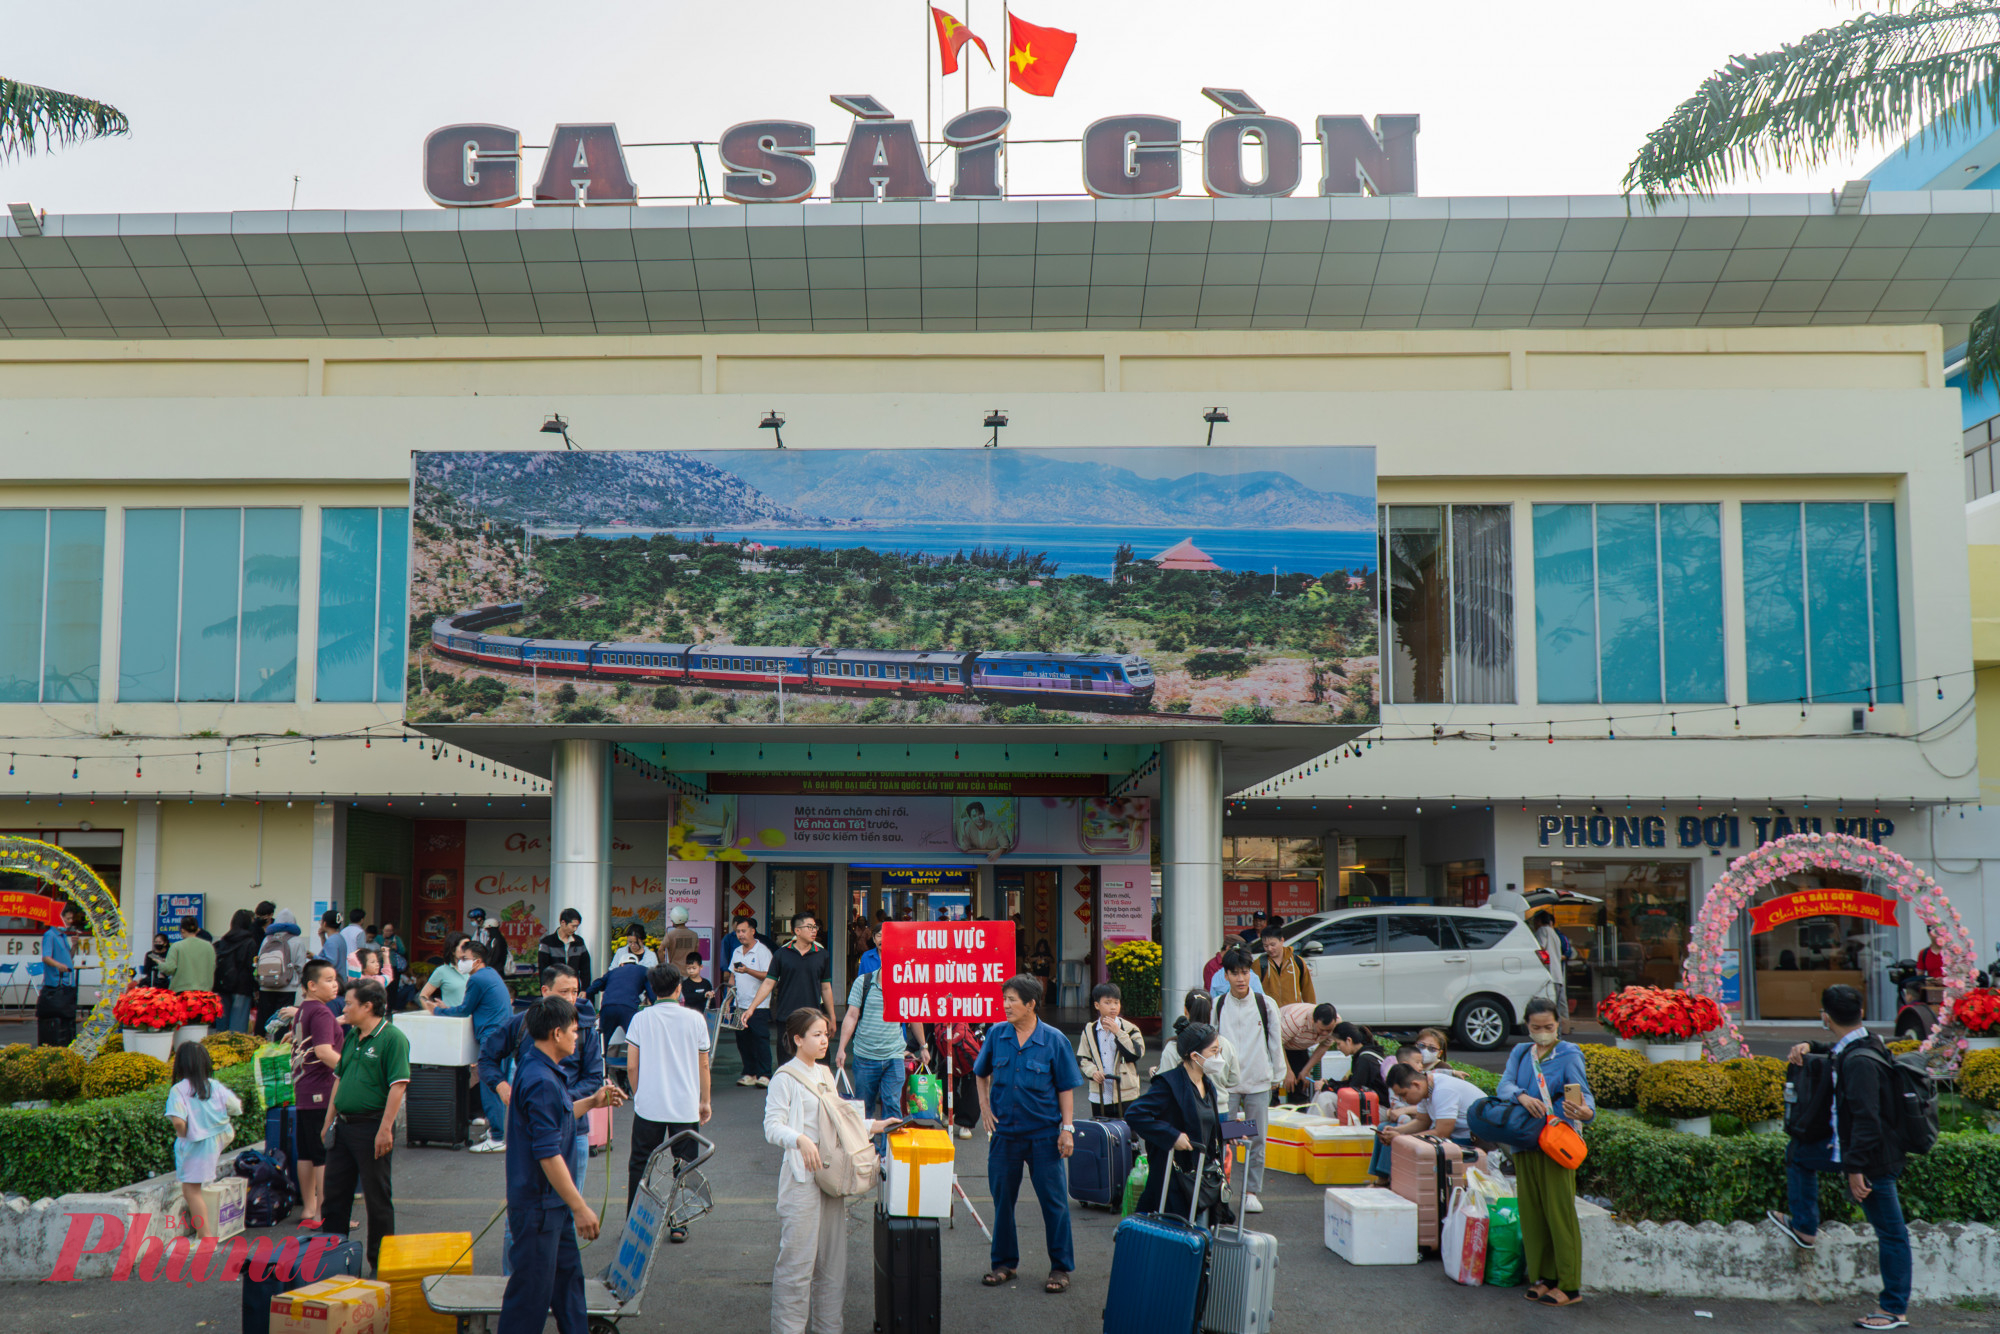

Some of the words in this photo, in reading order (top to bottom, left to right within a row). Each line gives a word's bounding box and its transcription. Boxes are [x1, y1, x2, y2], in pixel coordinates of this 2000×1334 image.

[423, 121, 639, 208] GA
[1082, 86, 1421, 200] GÒN
[816, 781, 828, 791] ĐẠI
[845, 781, 858, 791] ĐẠI
[880, 780, 899, 790] TOÀN
[901, 780, 921, 790] QUỐC
[957, 782, 969, 790] XIV
[795, 806, 817, 817] Một
[818, 806, 840, 816] năm
[843, 806, 872, 816] chăm
[874, 806, 890, 816] chỉ
[893, 806, 909, 816] rồi.
[796, 818, 809, 828] Về
[811, 820, 830, 828] nhà
[833, 820, 846, 828] ăn
[848, 819, 864, 829] Tết
[868, 820, 898, 829] trước,
[1538, 806, 1666, 848] PHÒNG
[1677, 811, 1741, 856] ĐỢI
[504, 832, 542, 853] Ga
[612, 836, 634, 851] òn
[794, 830, 810, 842] lấy
[812, 832, 830, 841] sức
[833, 831, 858, 841] kiếm
[861, 832, 880, 841] tiền
[474, 872, 528, 895] Chúc
[630, 876, 665, 894] Mới
[2, 894, 24, 903] GÒN
[1792, 895, 1806, 904] GA
[1809, 891, 1828, 901] SÀI
[1831, 890, 1854, 901] GÒN
[28, 906, 47, 918] 2026
[1768, 908, 1794, 923] Chúc
[1820, 902, 1840, 912] Năm
[1860, 905, 1880, 916] 2026
[7, 938, 23, 955] ÉP
[917, 930, 947, 949] KHU
[954, 927, 985, 953] VỰC
[893, 959, 929, 984] CẤM
[935, 960, 977, 984] DỪNG
[983, 963, 1004, 982] XE
[899, 994, 931, 1020] QUÁ
[937, 997, 947, 1017] 3
[953, 993, 994, 1017] PHÚT
